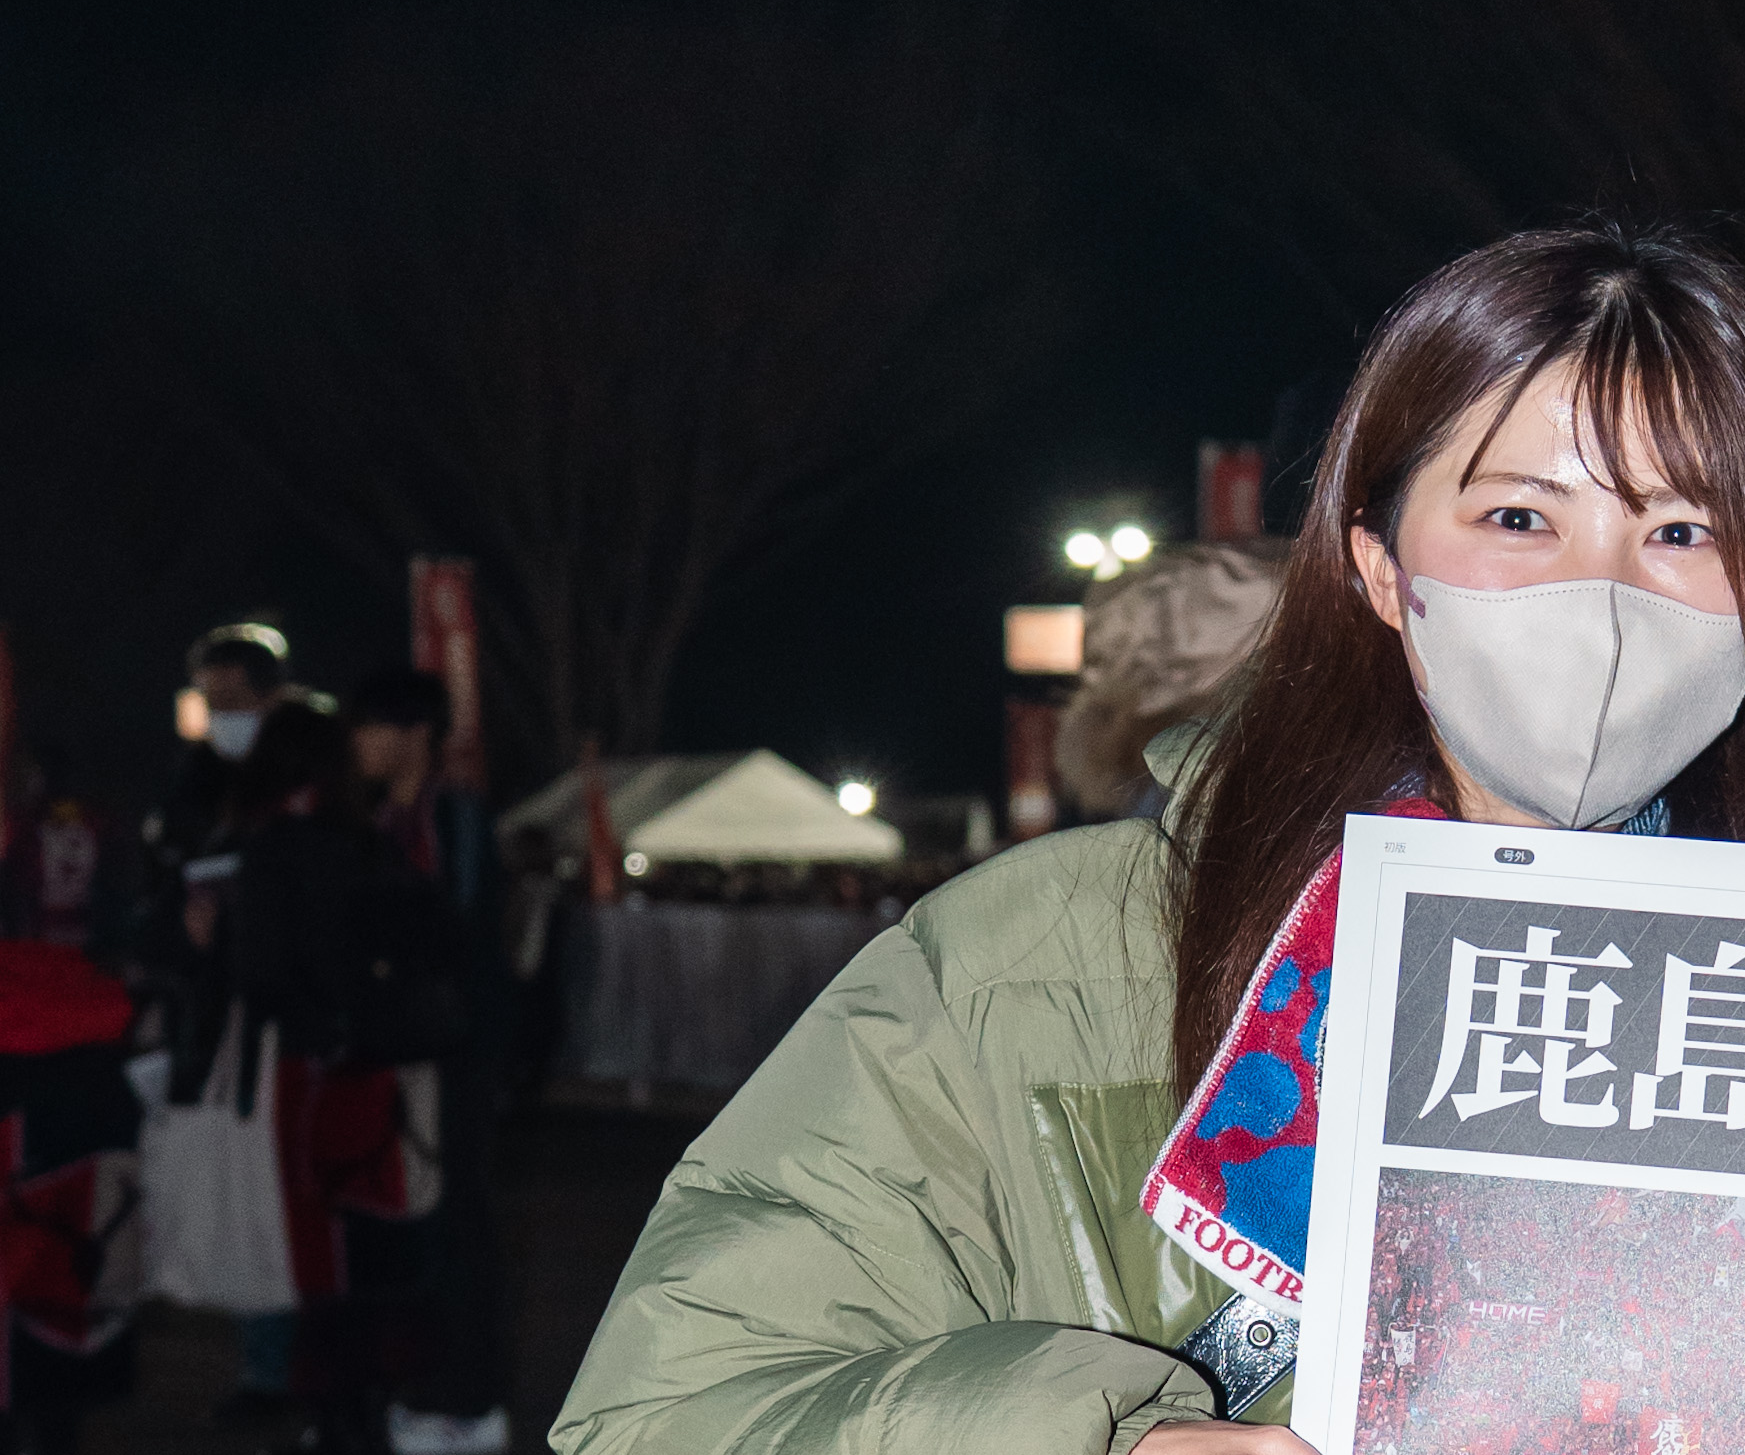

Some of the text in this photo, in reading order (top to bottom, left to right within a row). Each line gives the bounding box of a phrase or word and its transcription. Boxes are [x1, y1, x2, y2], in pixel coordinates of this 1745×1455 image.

[1384, 841, 1407, 854] 初版
[1502, 849, 1527, 863] 号外
[1174, 1204, 1304, 1303] FOOTB
[1469, 1301, 1546, 1326] HOME
